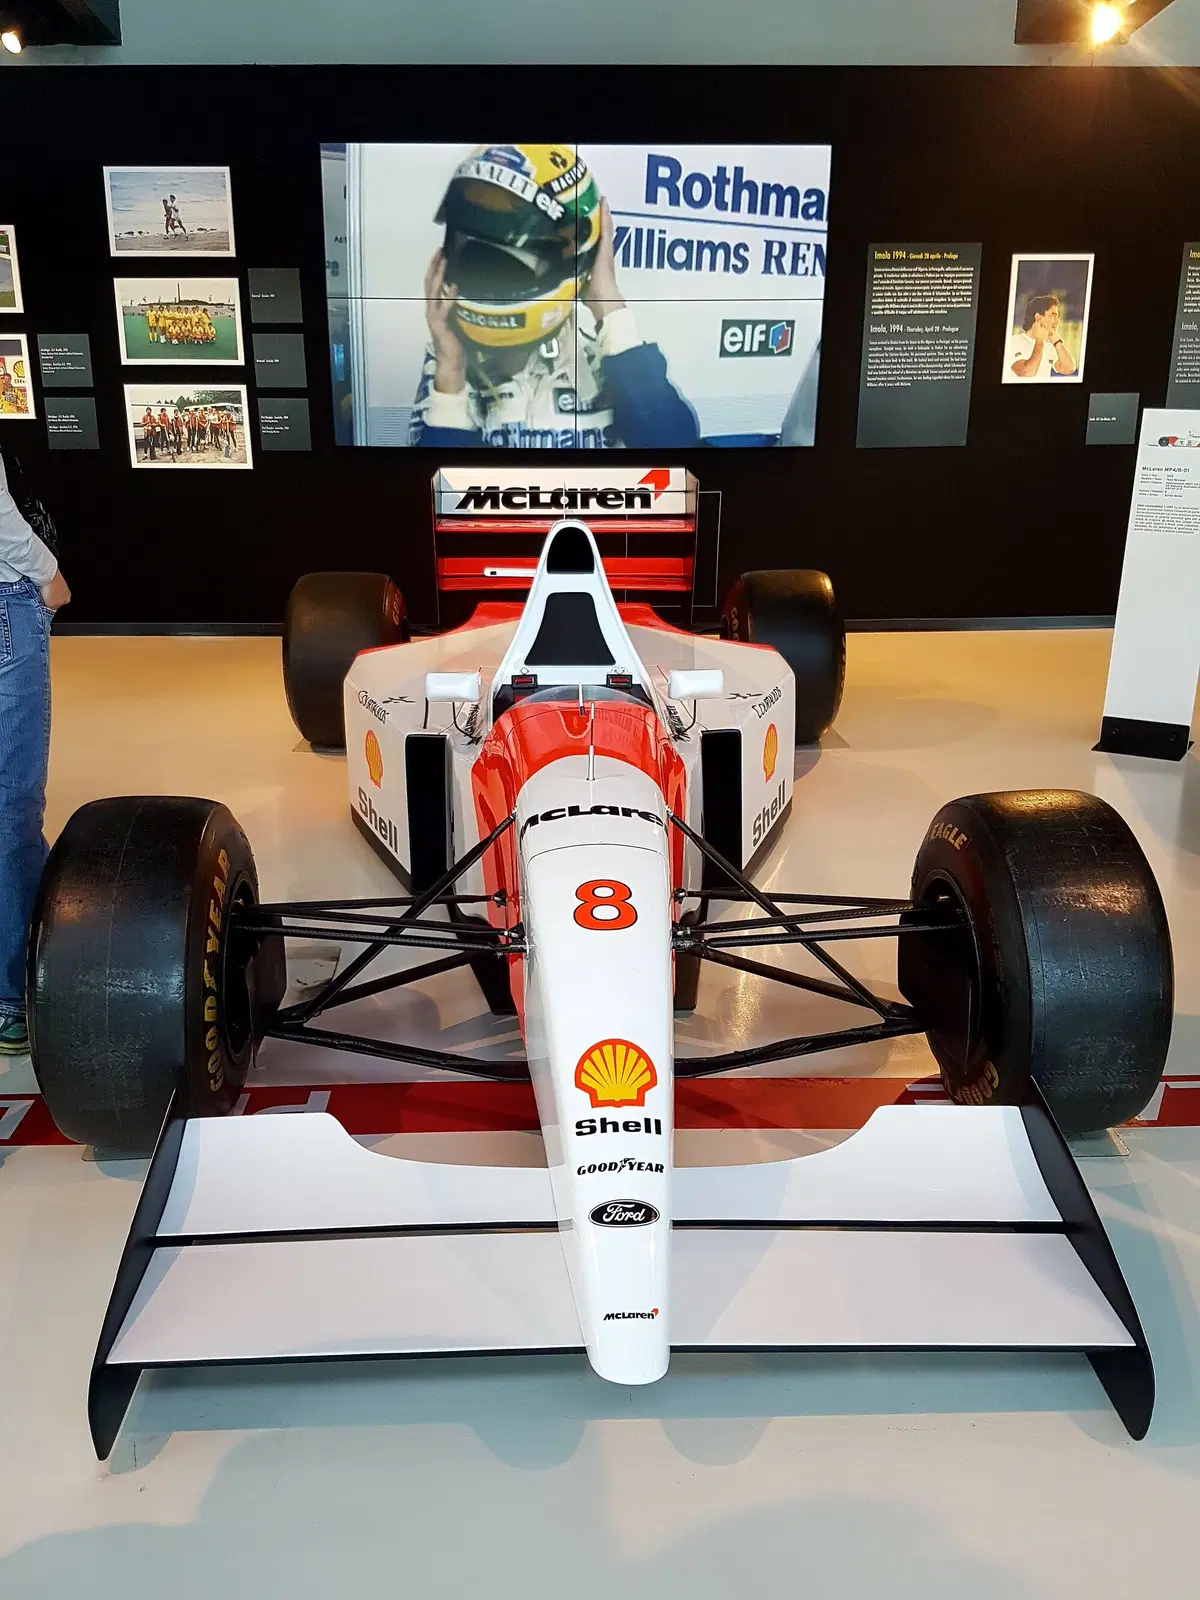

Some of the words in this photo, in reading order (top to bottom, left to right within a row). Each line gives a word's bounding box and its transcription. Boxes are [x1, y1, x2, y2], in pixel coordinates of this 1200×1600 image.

[645, 153, 829, 222] Rothma
[874, 250, 891, 260] Imola
[892, 250, 906, 260] 1994
[723, 324, 766, 354] elf
[890, 324, 904, 333] 1994
[455, 486, 652, 510] McLaren
[358, 786, 398, 854] Shell
[752, 779, 786, 847] Shell
[930, 823, 969, 850] EAGLE
[573, 879, 638, 931] 8
[204, 848, 231, 1092] GOODYEAR
[575, 1117, 662, 1136] Shell
[602, 1203, 646, 1223] Ford
[603, 1308, 655, 1321] McLaren
